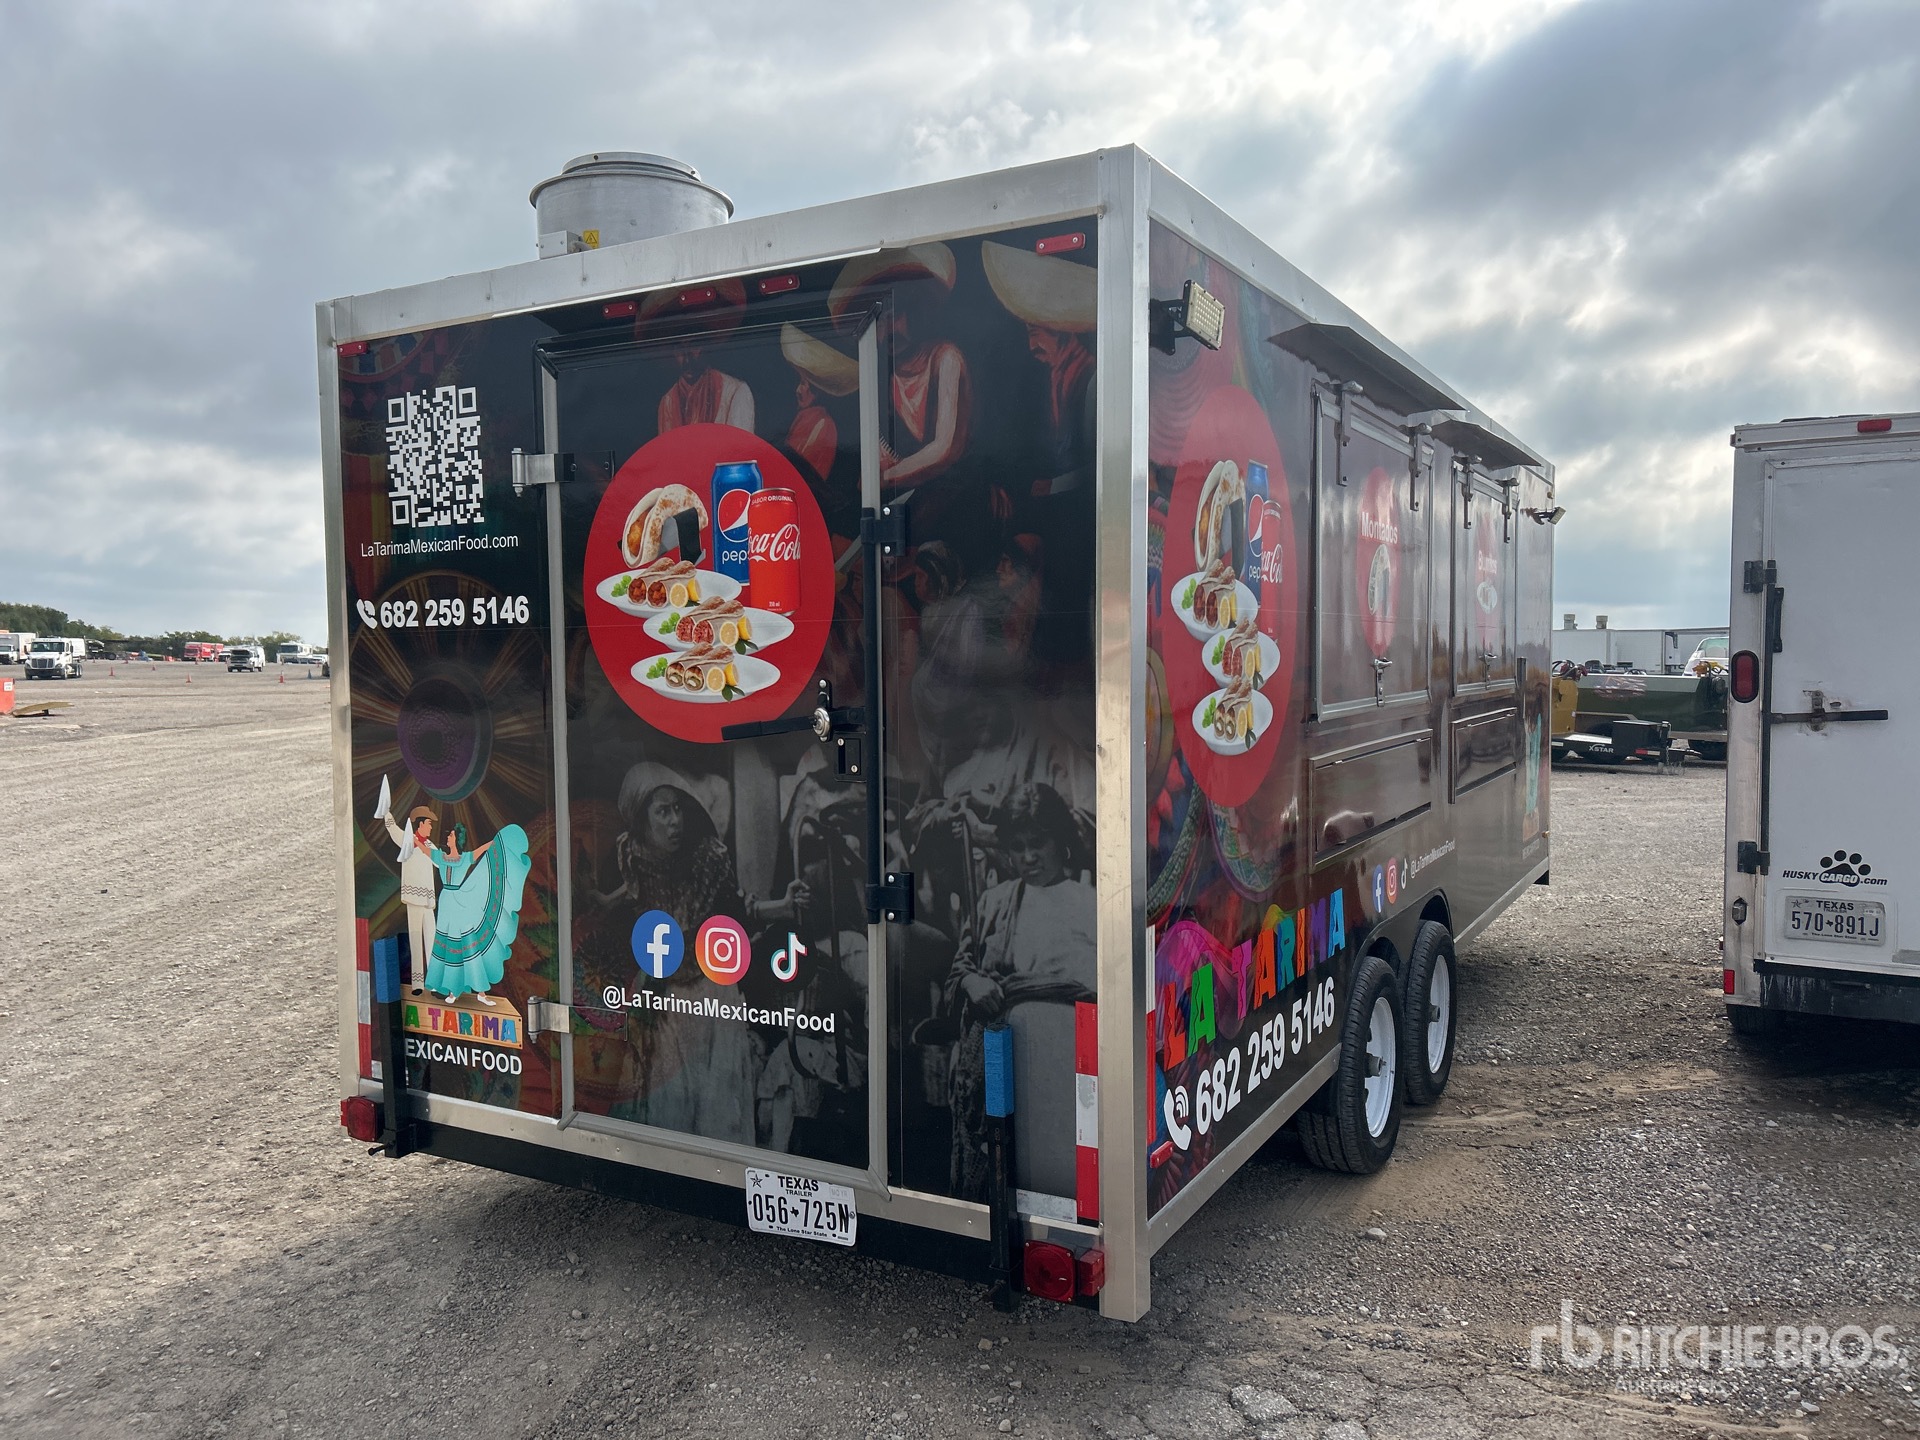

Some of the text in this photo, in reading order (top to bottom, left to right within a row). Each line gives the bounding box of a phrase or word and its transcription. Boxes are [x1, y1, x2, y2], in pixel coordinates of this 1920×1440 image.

[748, 523, 800, 562] ca-Col
[1361, 511, 1398, 544] Montados
[361, 534, 519, 557] LaTarimaMexicanFood.com
[722, 550, 748, 565] pep
[380, 595, 530, 629] 682 259 5146
[1816, 900, 1854, 911] TEXAS
[1791, 911, 1879, 937] 570 891J
[1163, 888, 1347, 1072] LA TARIMA
[405, 1004, 518, 1044] A TARIMA
[602, 985, 836, 1033] @LaTarimaMexicanFood
[405, 1038, 523, 1076] EXICAN FOOD
[1195, 975, 1335, 1135] 682 259 5146
[777, 1175, 819, 1192] TEXAS
[785, 1188, 813, 1198] TRAILER
[752, 1193, 850, 1234] 056 725N
